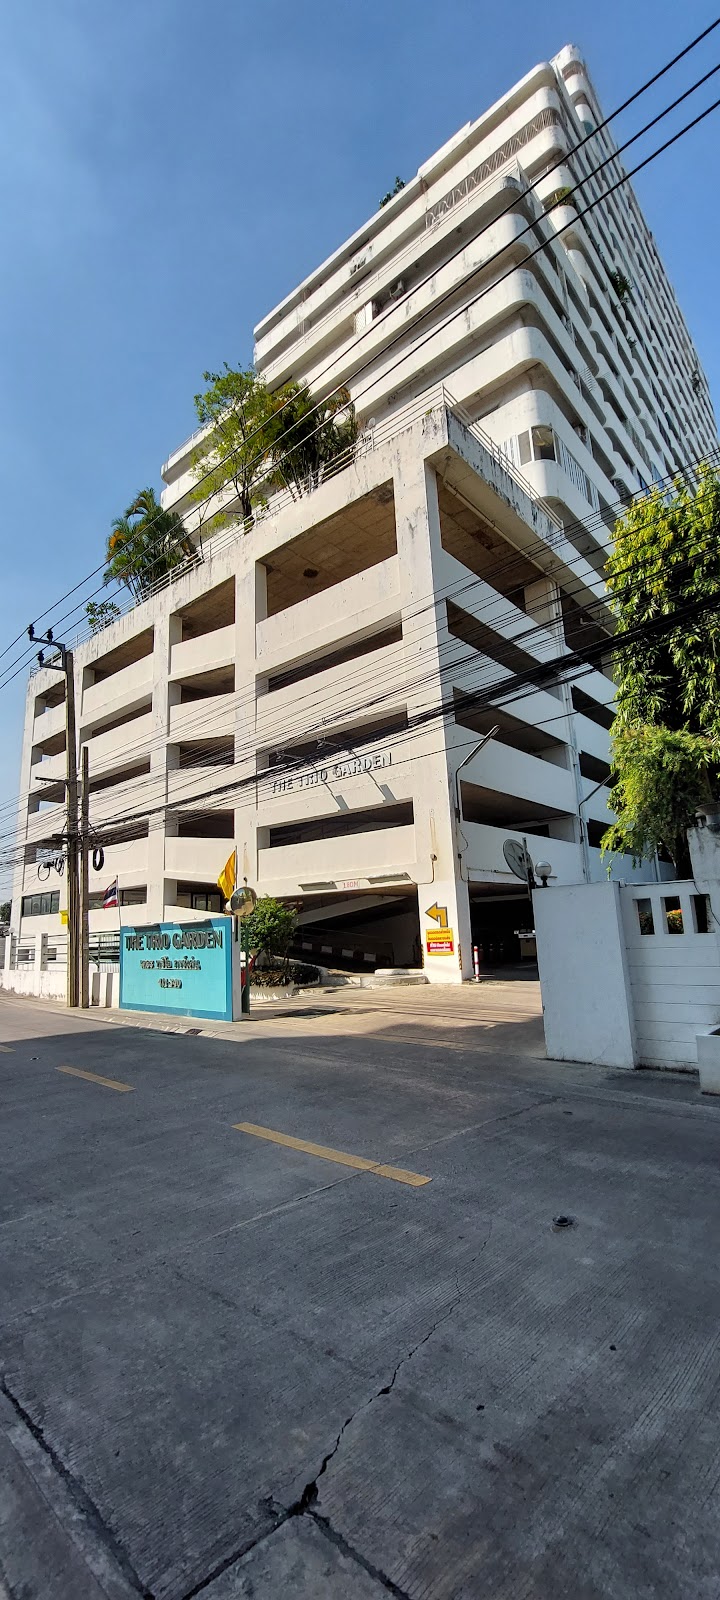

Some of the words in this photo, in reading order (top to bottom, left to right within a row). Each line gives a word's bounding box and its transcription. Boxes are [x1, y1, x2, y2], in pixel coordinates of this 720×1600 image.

[272, 778, 294, 793] THE
[299, 770, 328, 787] TRIO
[332, 752, 392, 778] GARDEN
[124, 935, 144, 951] THE
[145, 933, 171, 950] TRIO
[172, 930, 223, 950] GARDEN
